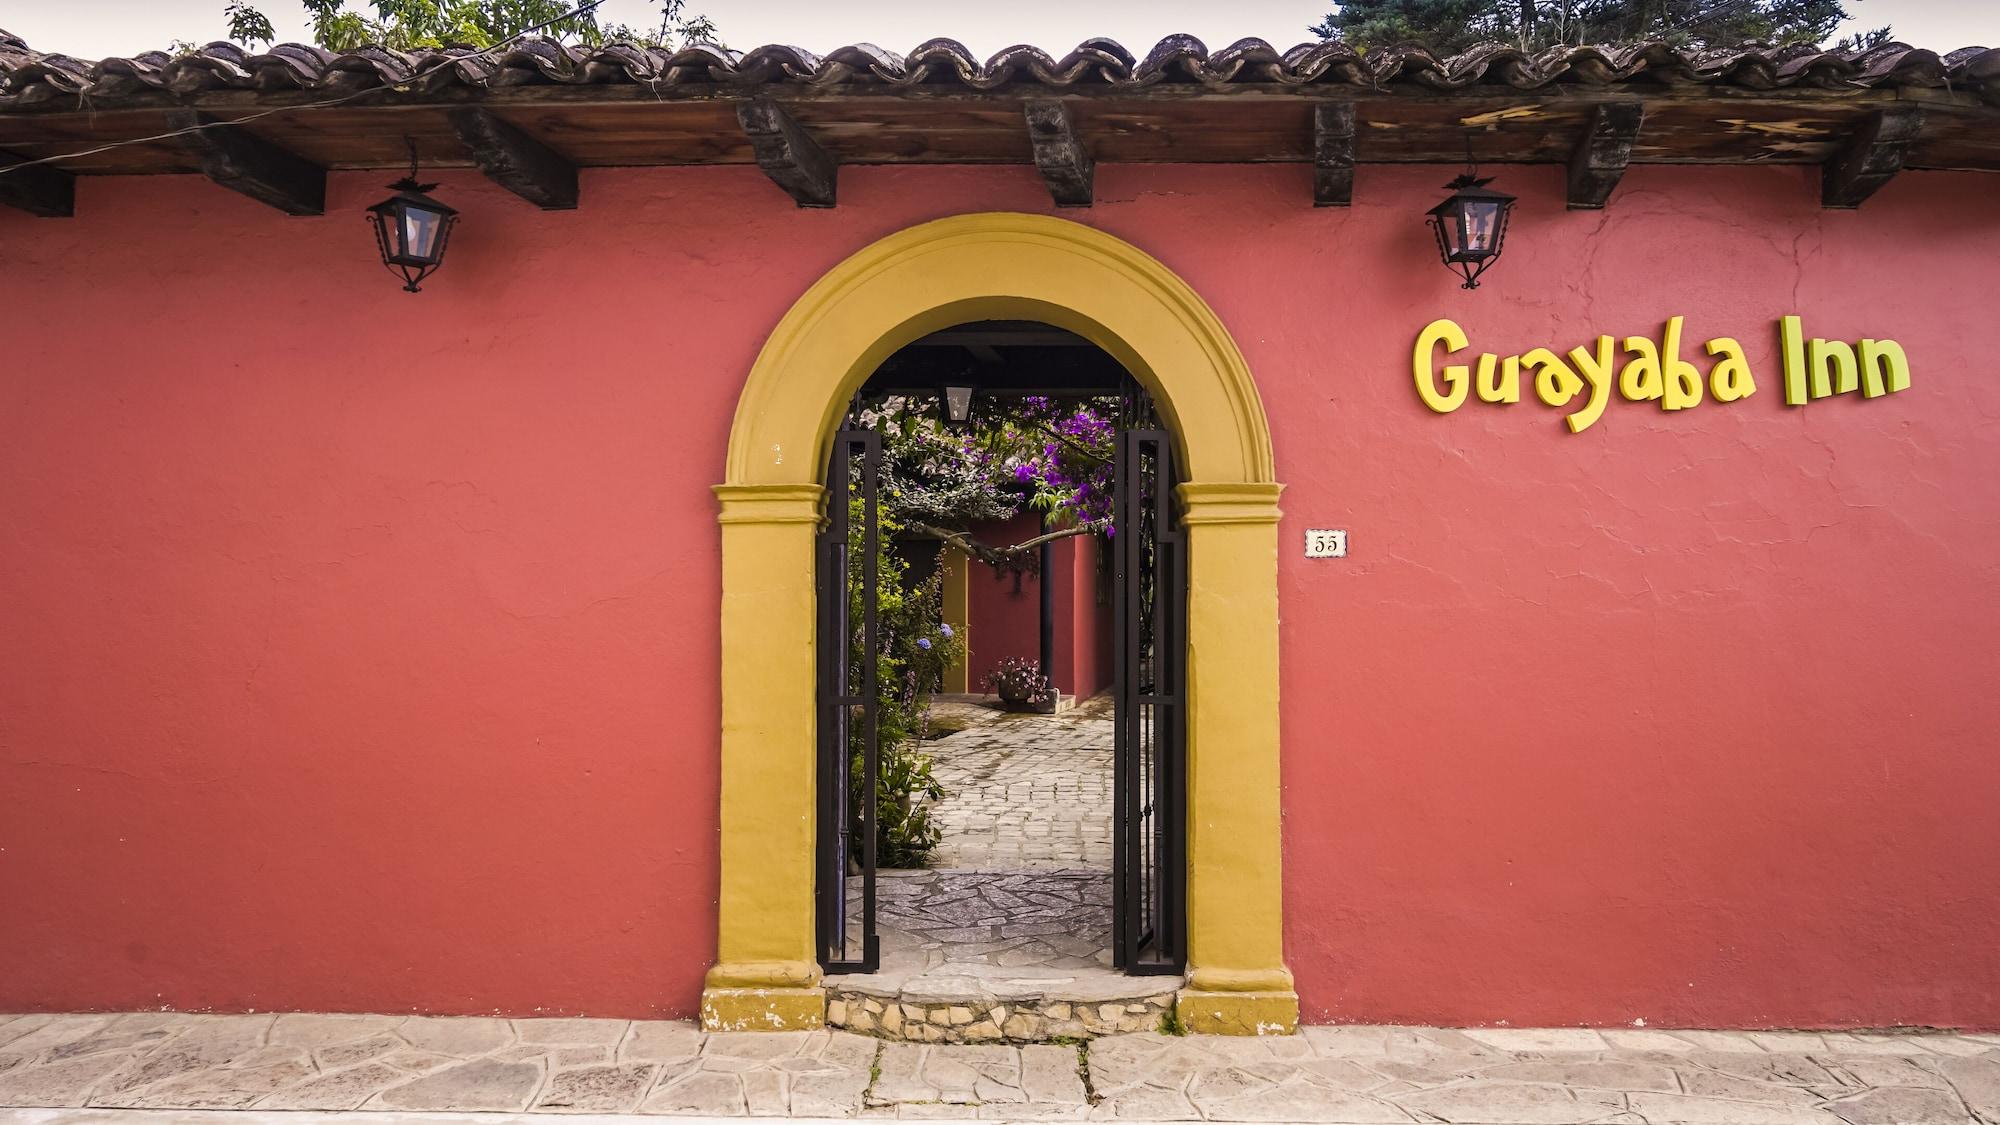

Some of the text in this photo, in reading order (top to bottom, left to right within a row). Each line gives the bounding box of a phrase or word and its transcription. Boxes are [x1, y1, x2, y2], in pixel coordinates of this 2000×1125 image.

[1413, 315, 1911, 433] Guayaba Inn
[1315, 535, 1337, 552] 55
